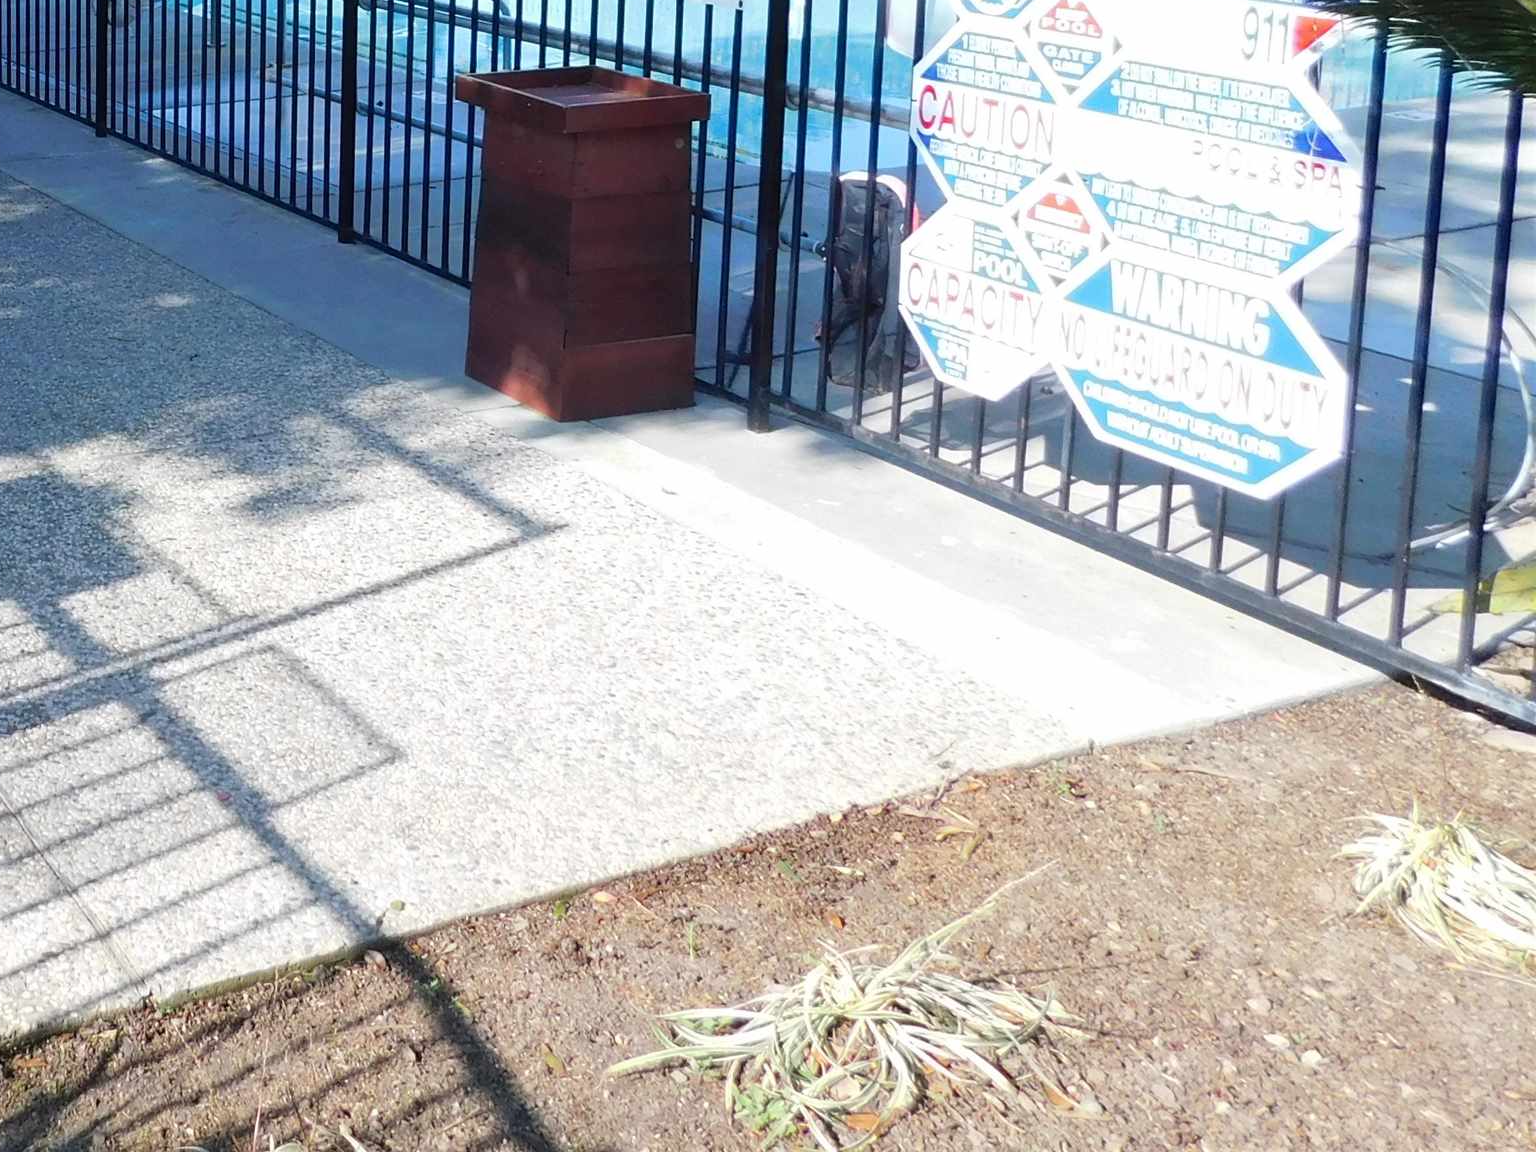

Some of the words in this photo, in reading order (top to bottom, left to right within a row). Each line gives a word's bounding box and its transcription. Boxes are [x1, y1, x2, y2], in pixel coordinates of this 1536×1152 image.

[1040, 16, 1102, 38] POOL
[1043, 44, 1094, 64] GATE
[1241, 5, 1292, 65] 911
[918, 84, 1055, 159] CAUTION
[1294, 159, 1344, 199] SPA
[974, 252, 1028, 286] POOL
[907, 261, 1045, 346] CAPACITY
[1109, 258, 1272, 356] WARNING
[1059, 306, 1087, 360] NO
[1220, 359, 1252, 416] ON
[1264, 369, 1329, 431] DUTY
